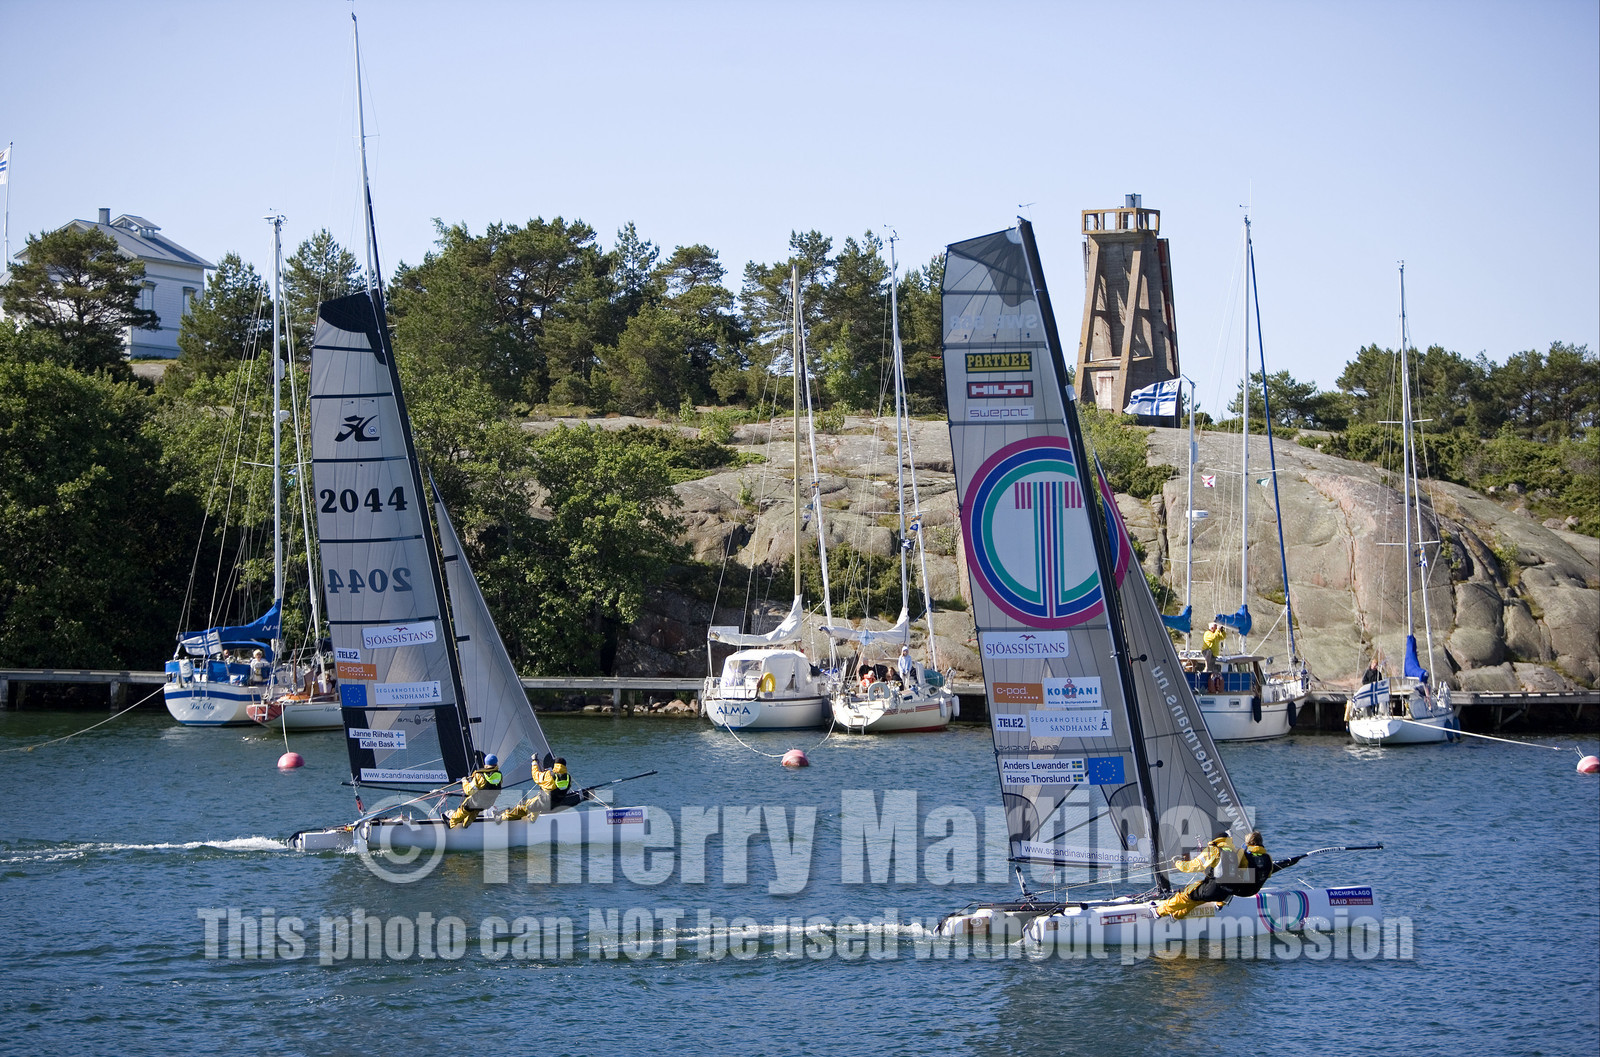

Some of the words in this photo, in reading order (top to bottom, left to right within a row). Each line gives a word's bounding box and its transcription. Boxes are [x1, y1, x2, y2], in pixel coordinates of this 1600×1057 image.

[966, 353, 1030, 367] PARTNER
[971, 384, 1029, 395] HILTI
[319, 486, 408, 514] 2044
[365, 630, 434, 646] SJÖASSISTANS
[985, 641, 1066, 656] SJÖASSISTANS
[375, 686, 430, 694] SEGLARHOTELLET
[1047, 687, 1098, 696] KOMPANI
[716, 706, 751, 715] ALMA
[352, 730, 371, 738] Janne
[361, 740, 378, 748] Kalle
[378, 741, 395, 749] Bask
[1003, 761, 1030, 770] Anders
[1031, 760, 1069, 770] Lewander
[363, 771, 448, 780] www.scandinavianislands
[1006, 775, 1030, 783] Hanse
[1032, 774, 1071, 783] Thorslund
